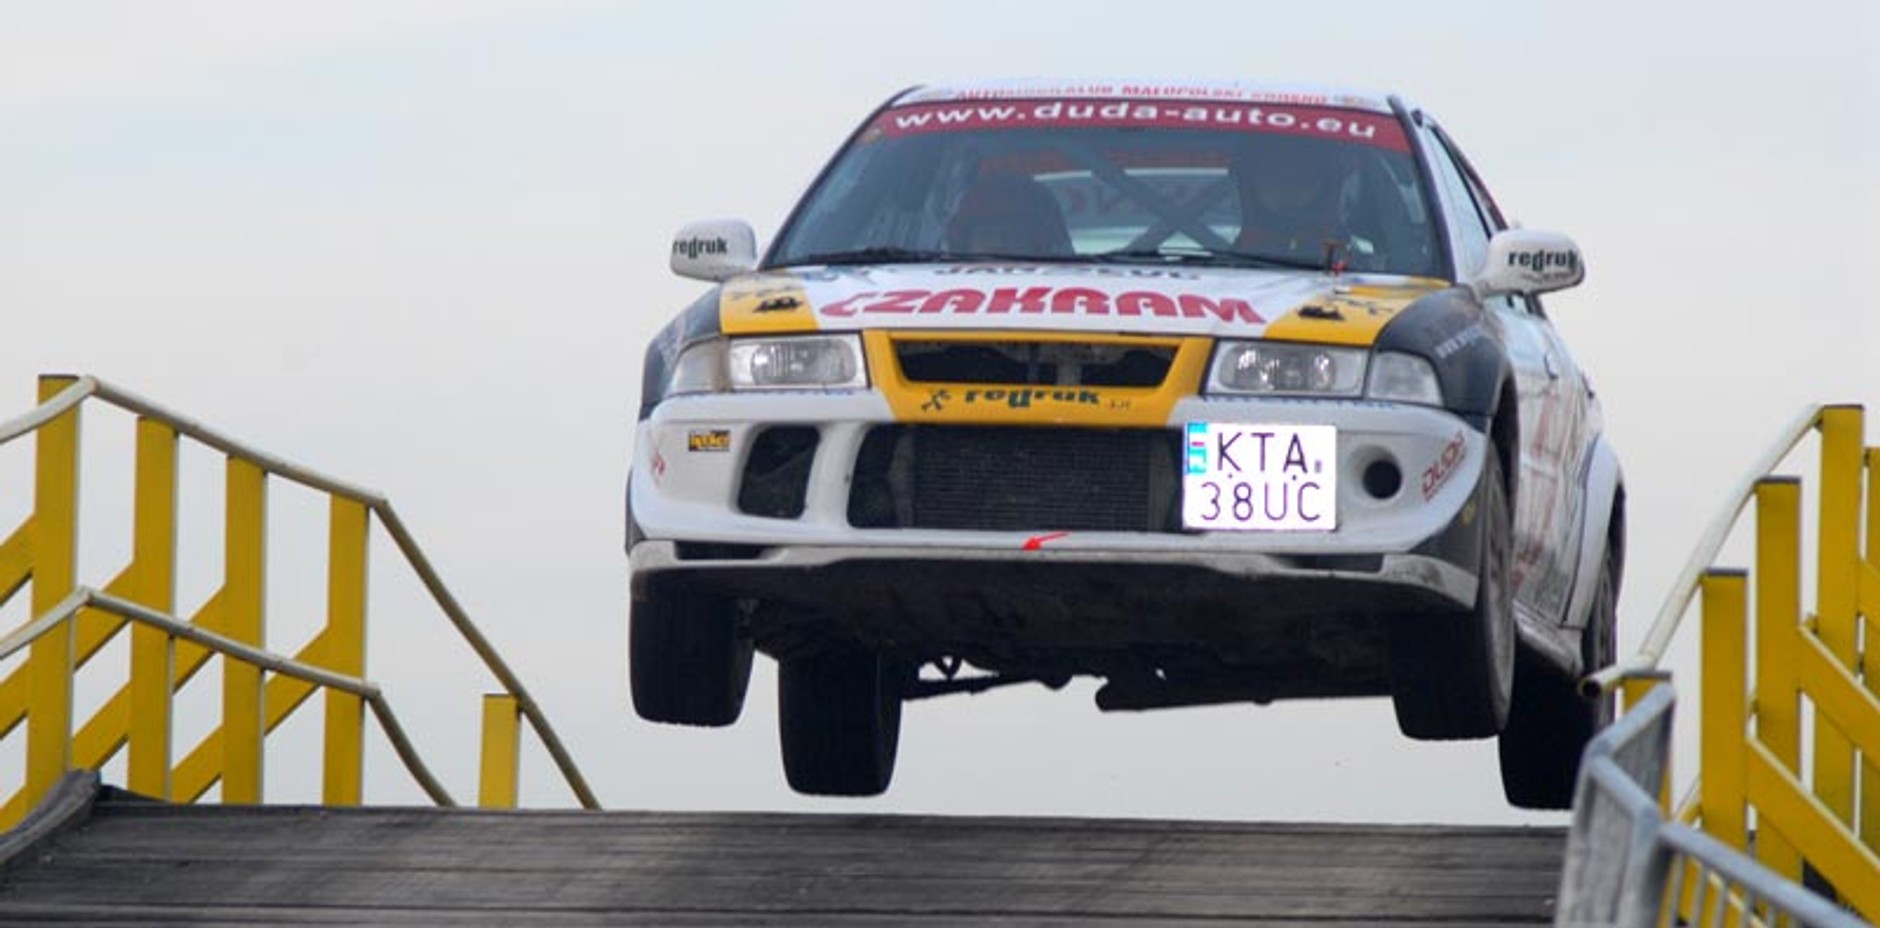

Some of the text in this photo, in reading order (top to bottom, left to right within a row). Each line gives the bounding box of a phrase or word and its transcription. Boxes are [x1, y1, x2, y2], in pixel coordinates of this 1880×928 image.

[894, 101, 1377, 139] www.duda-auto.eu
[1217, 432, 1308, 474] KTA
[1200, 481, 1321, 522] 38UC
